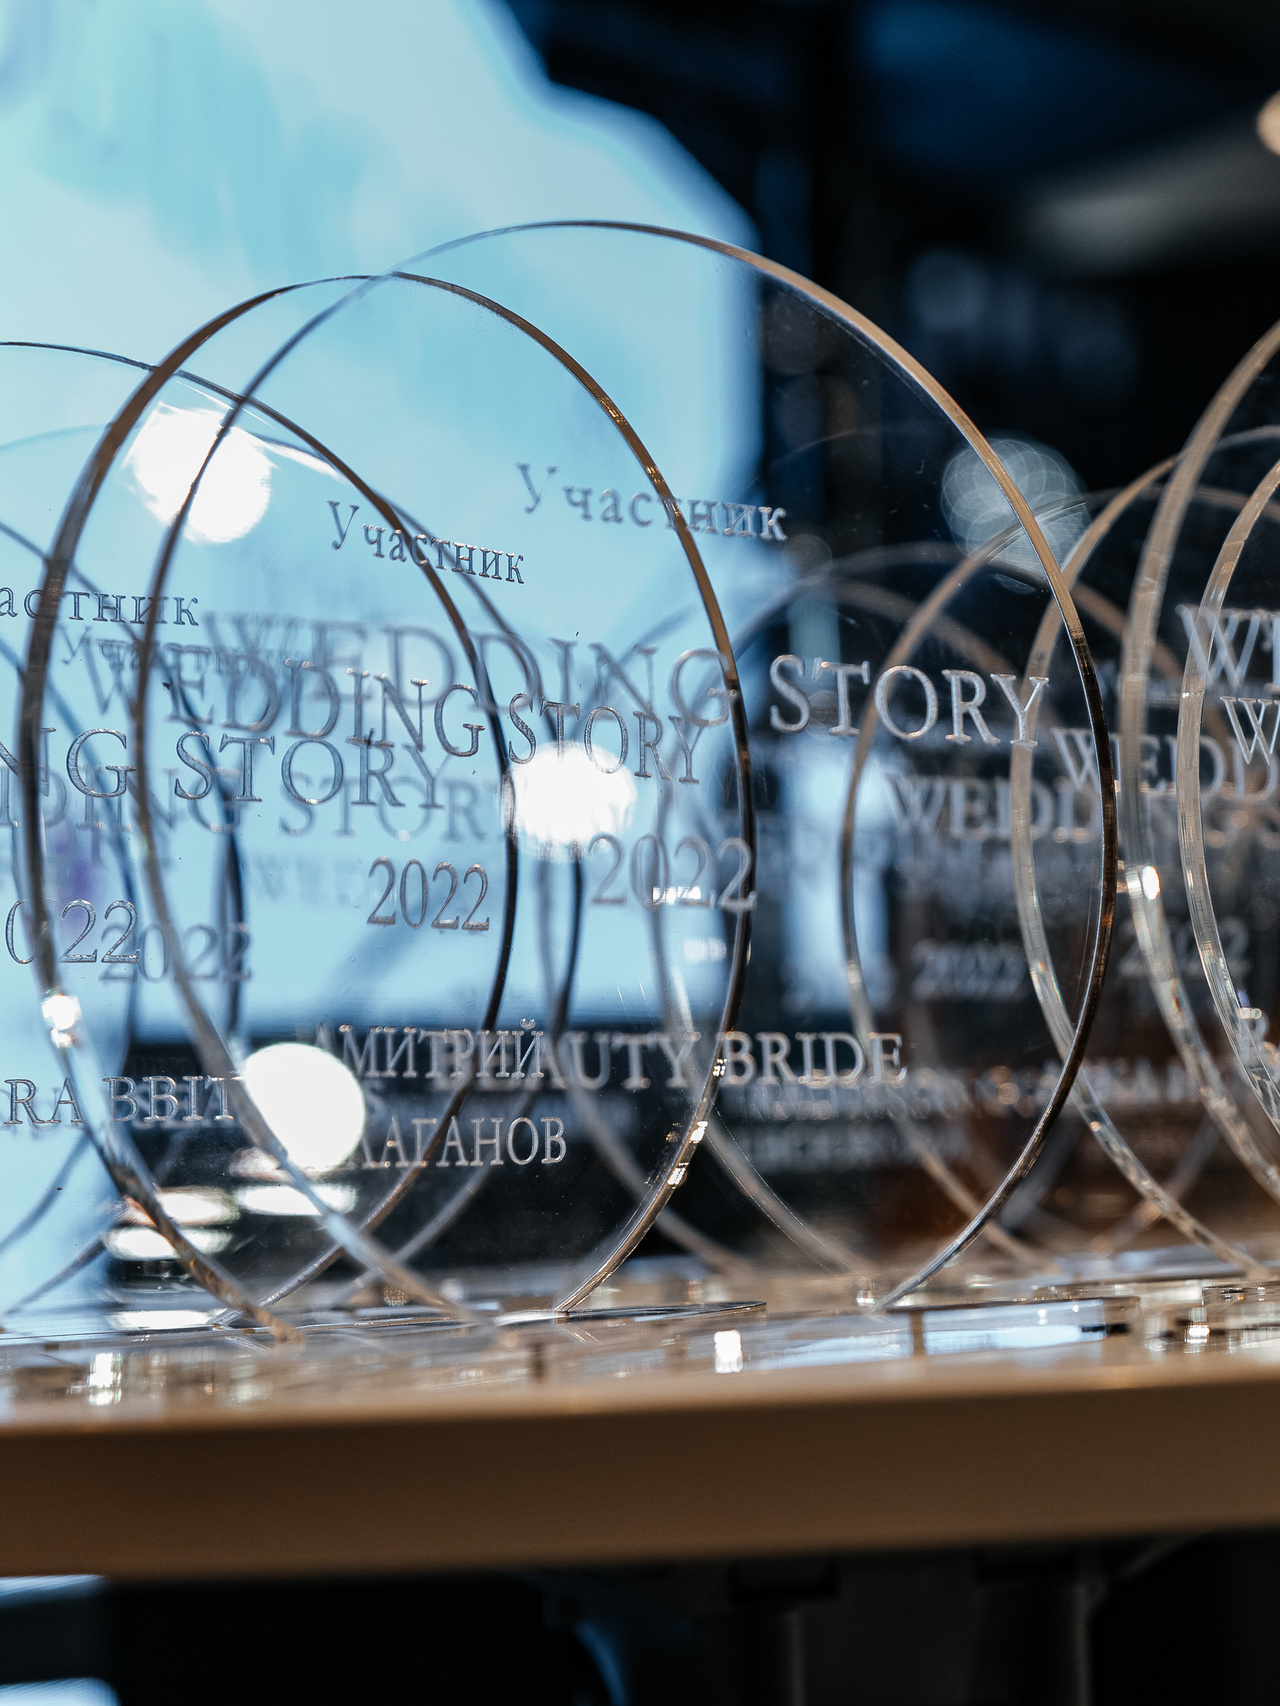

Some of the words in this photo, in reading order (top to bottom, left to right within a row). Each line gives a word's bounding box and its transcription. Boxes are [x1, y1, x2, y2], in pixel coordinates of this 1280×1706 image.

[514, 461, 788, 541] Участник
[326, 499, 525, 584] Участник
[507, 690, 703, 784] STORY
[768, 652, 1050, 748] STORY
[174, 728, 448, 810] STORY
[367, 855, 491, 932] 2022
[587, 832, 760, 912] 2022
[716, 1030, 908, 1088] BRIDE
[355, 1115, 568, 1169] АГАНОВ
